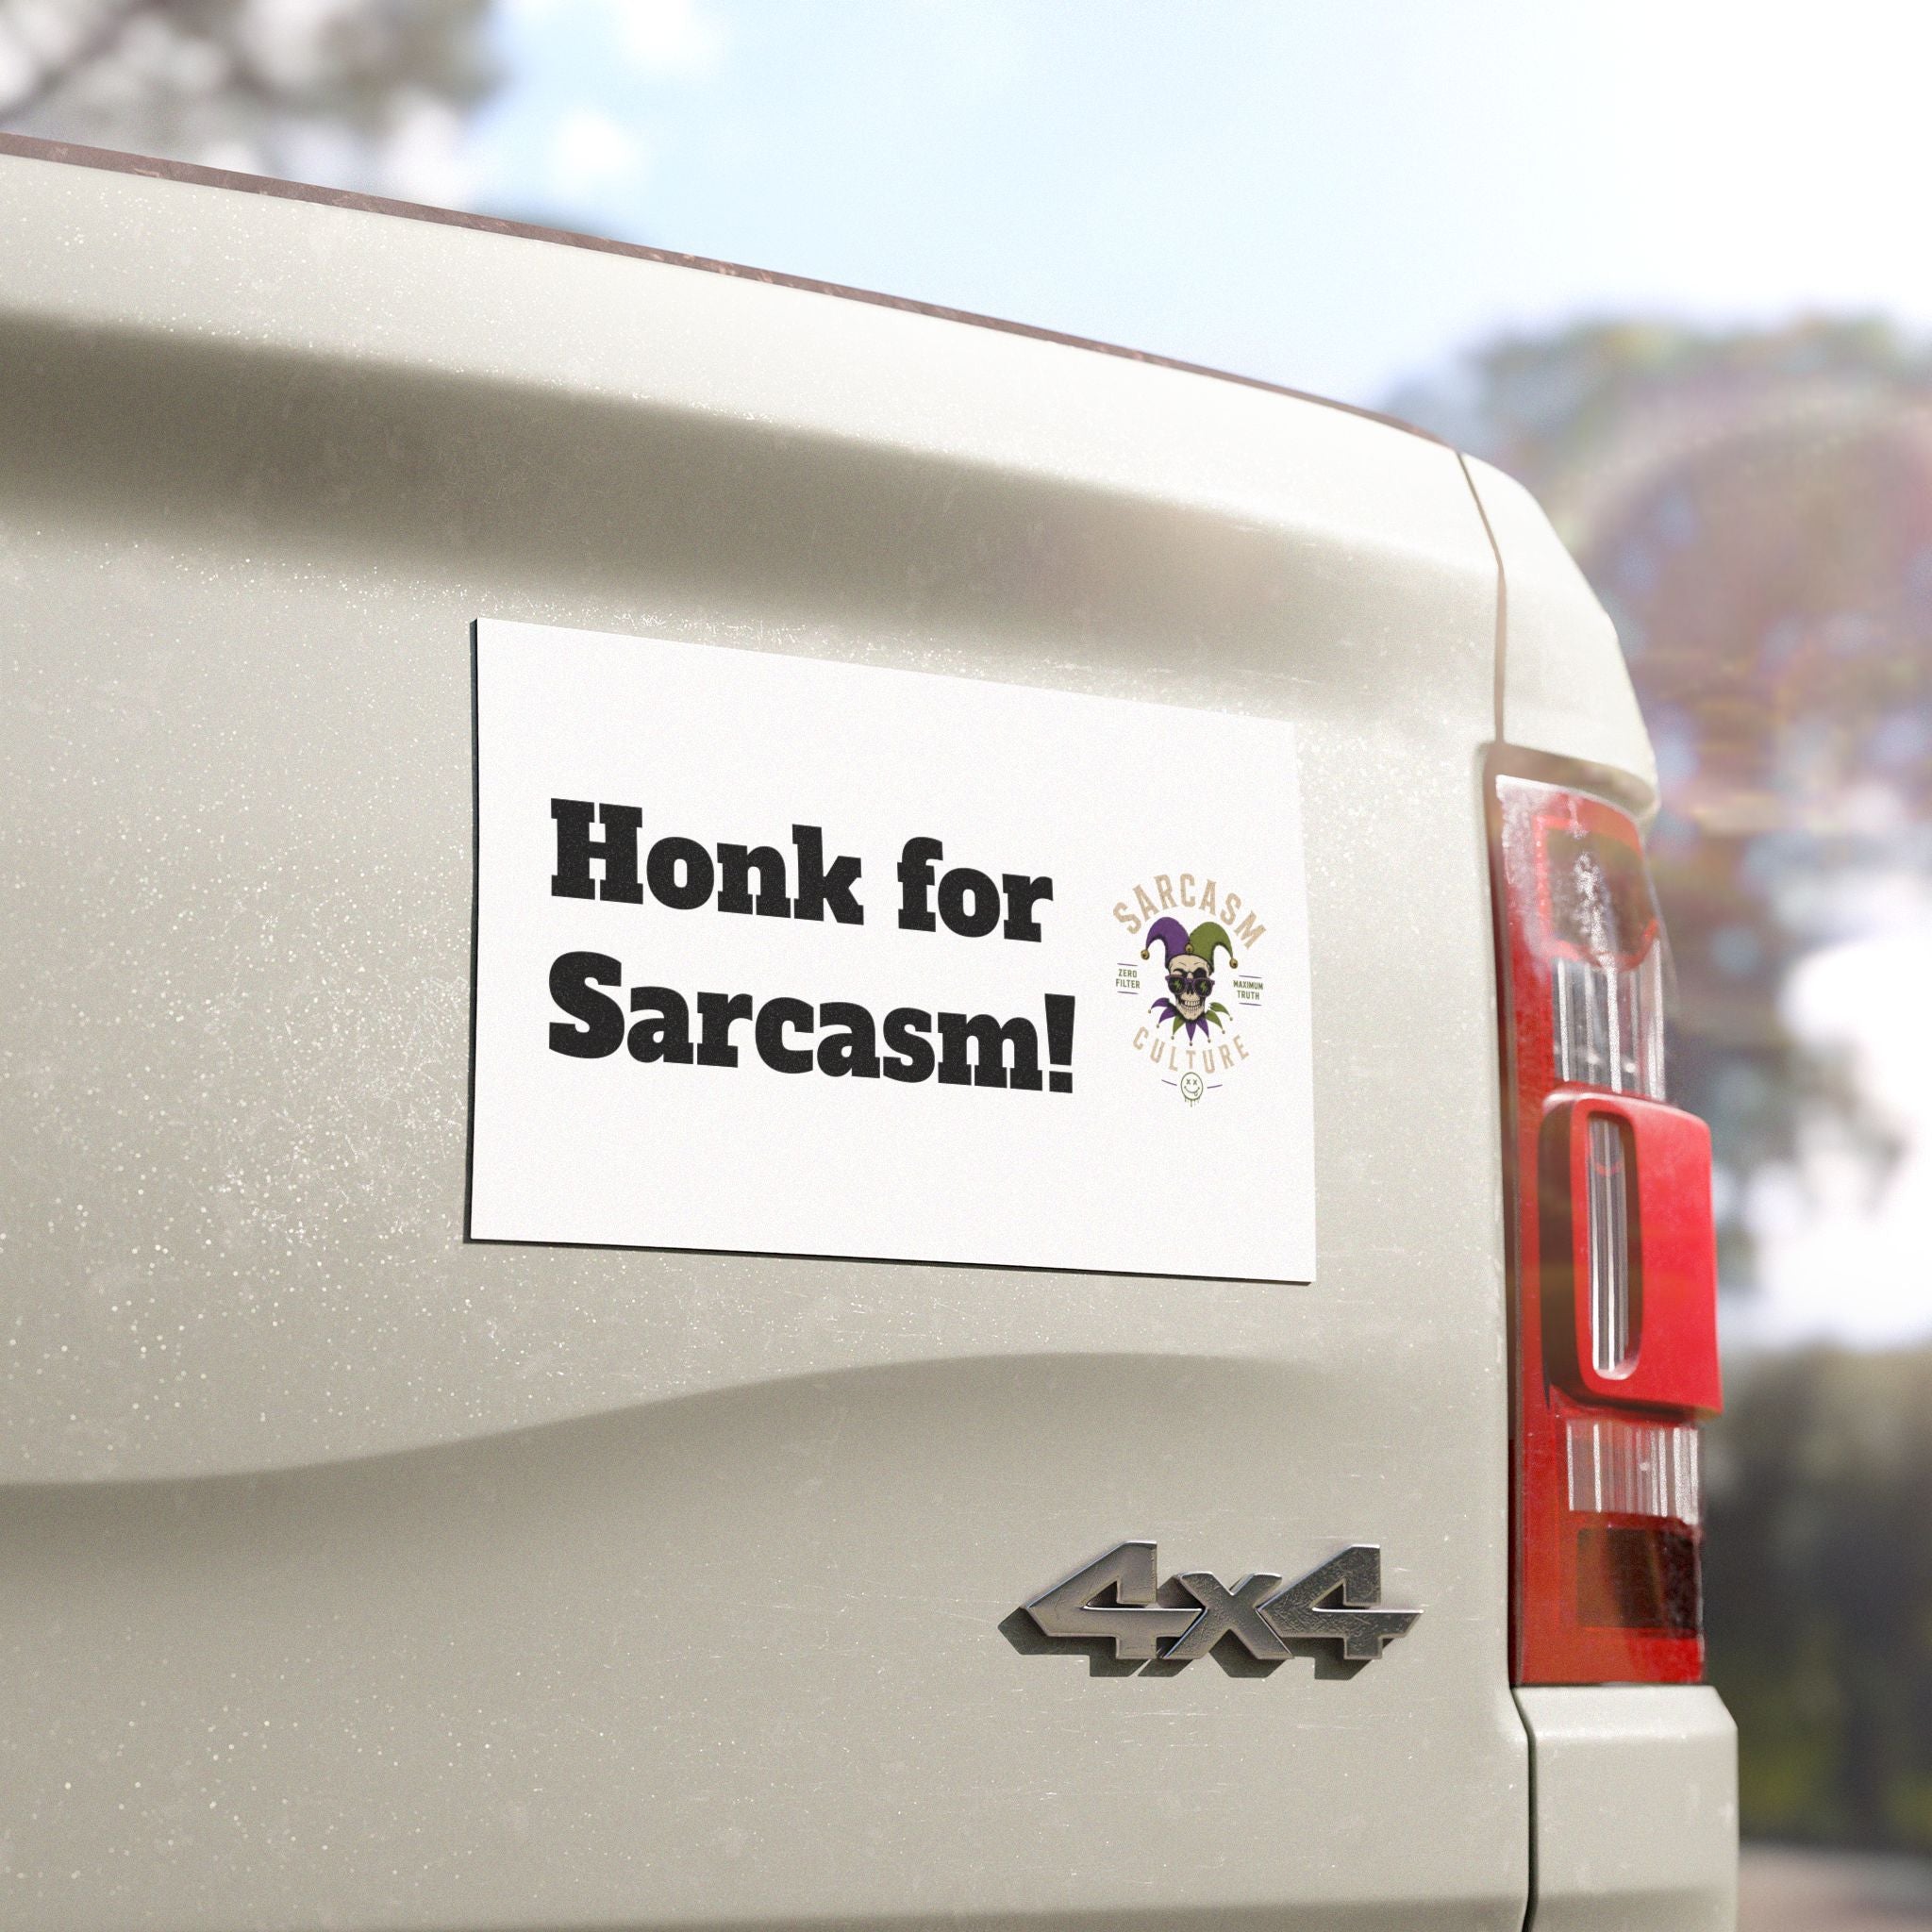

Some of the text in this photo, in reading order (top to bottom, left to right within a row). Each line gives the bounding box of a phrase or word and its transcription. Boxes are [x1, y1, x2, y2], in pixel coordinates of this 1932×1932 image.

[550, 797, 1055, 943] Honk for
[1112, 873, 1267, 950] SARCASM
[1115, 978, 1141, 990] FILTER
[1118, 968, 1138, 979] ZERO
[1233, 979, 1264, 991] MAXIMUM
[1237, 991, 1260, 1001] TRUTH
[548, 950, 1076, 1094] Sarcasm!
[1132, 1026, 1250, 1074] CULTURE
